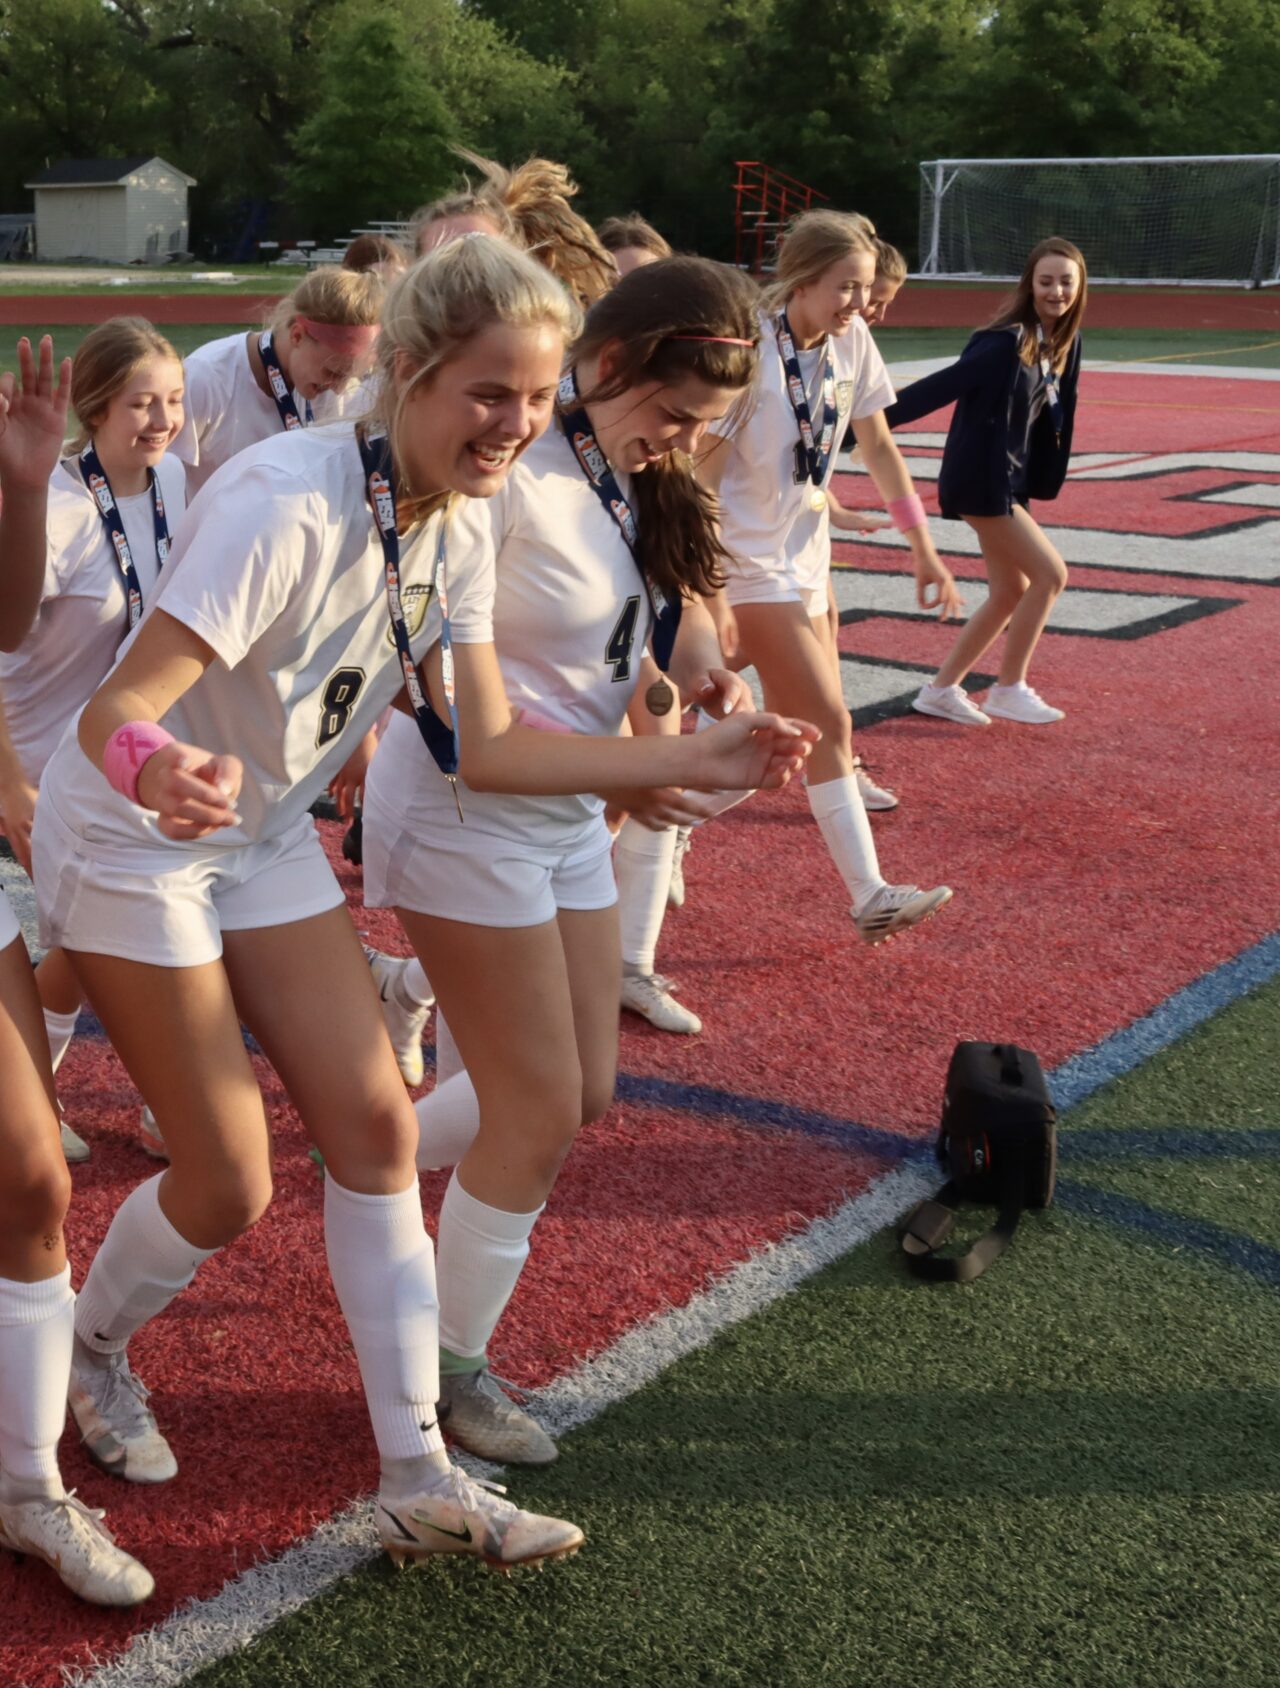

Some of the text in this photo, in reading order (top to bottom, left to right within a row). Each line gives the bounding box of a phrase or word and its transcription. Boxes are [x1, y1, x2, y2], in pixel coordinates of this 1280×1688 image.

[372, 479, 396, 532] IHSA
[605, 595, 641, 683] 4
[315, 666, 366, 750] 8
[404, 660, 426, 710] IHSA
